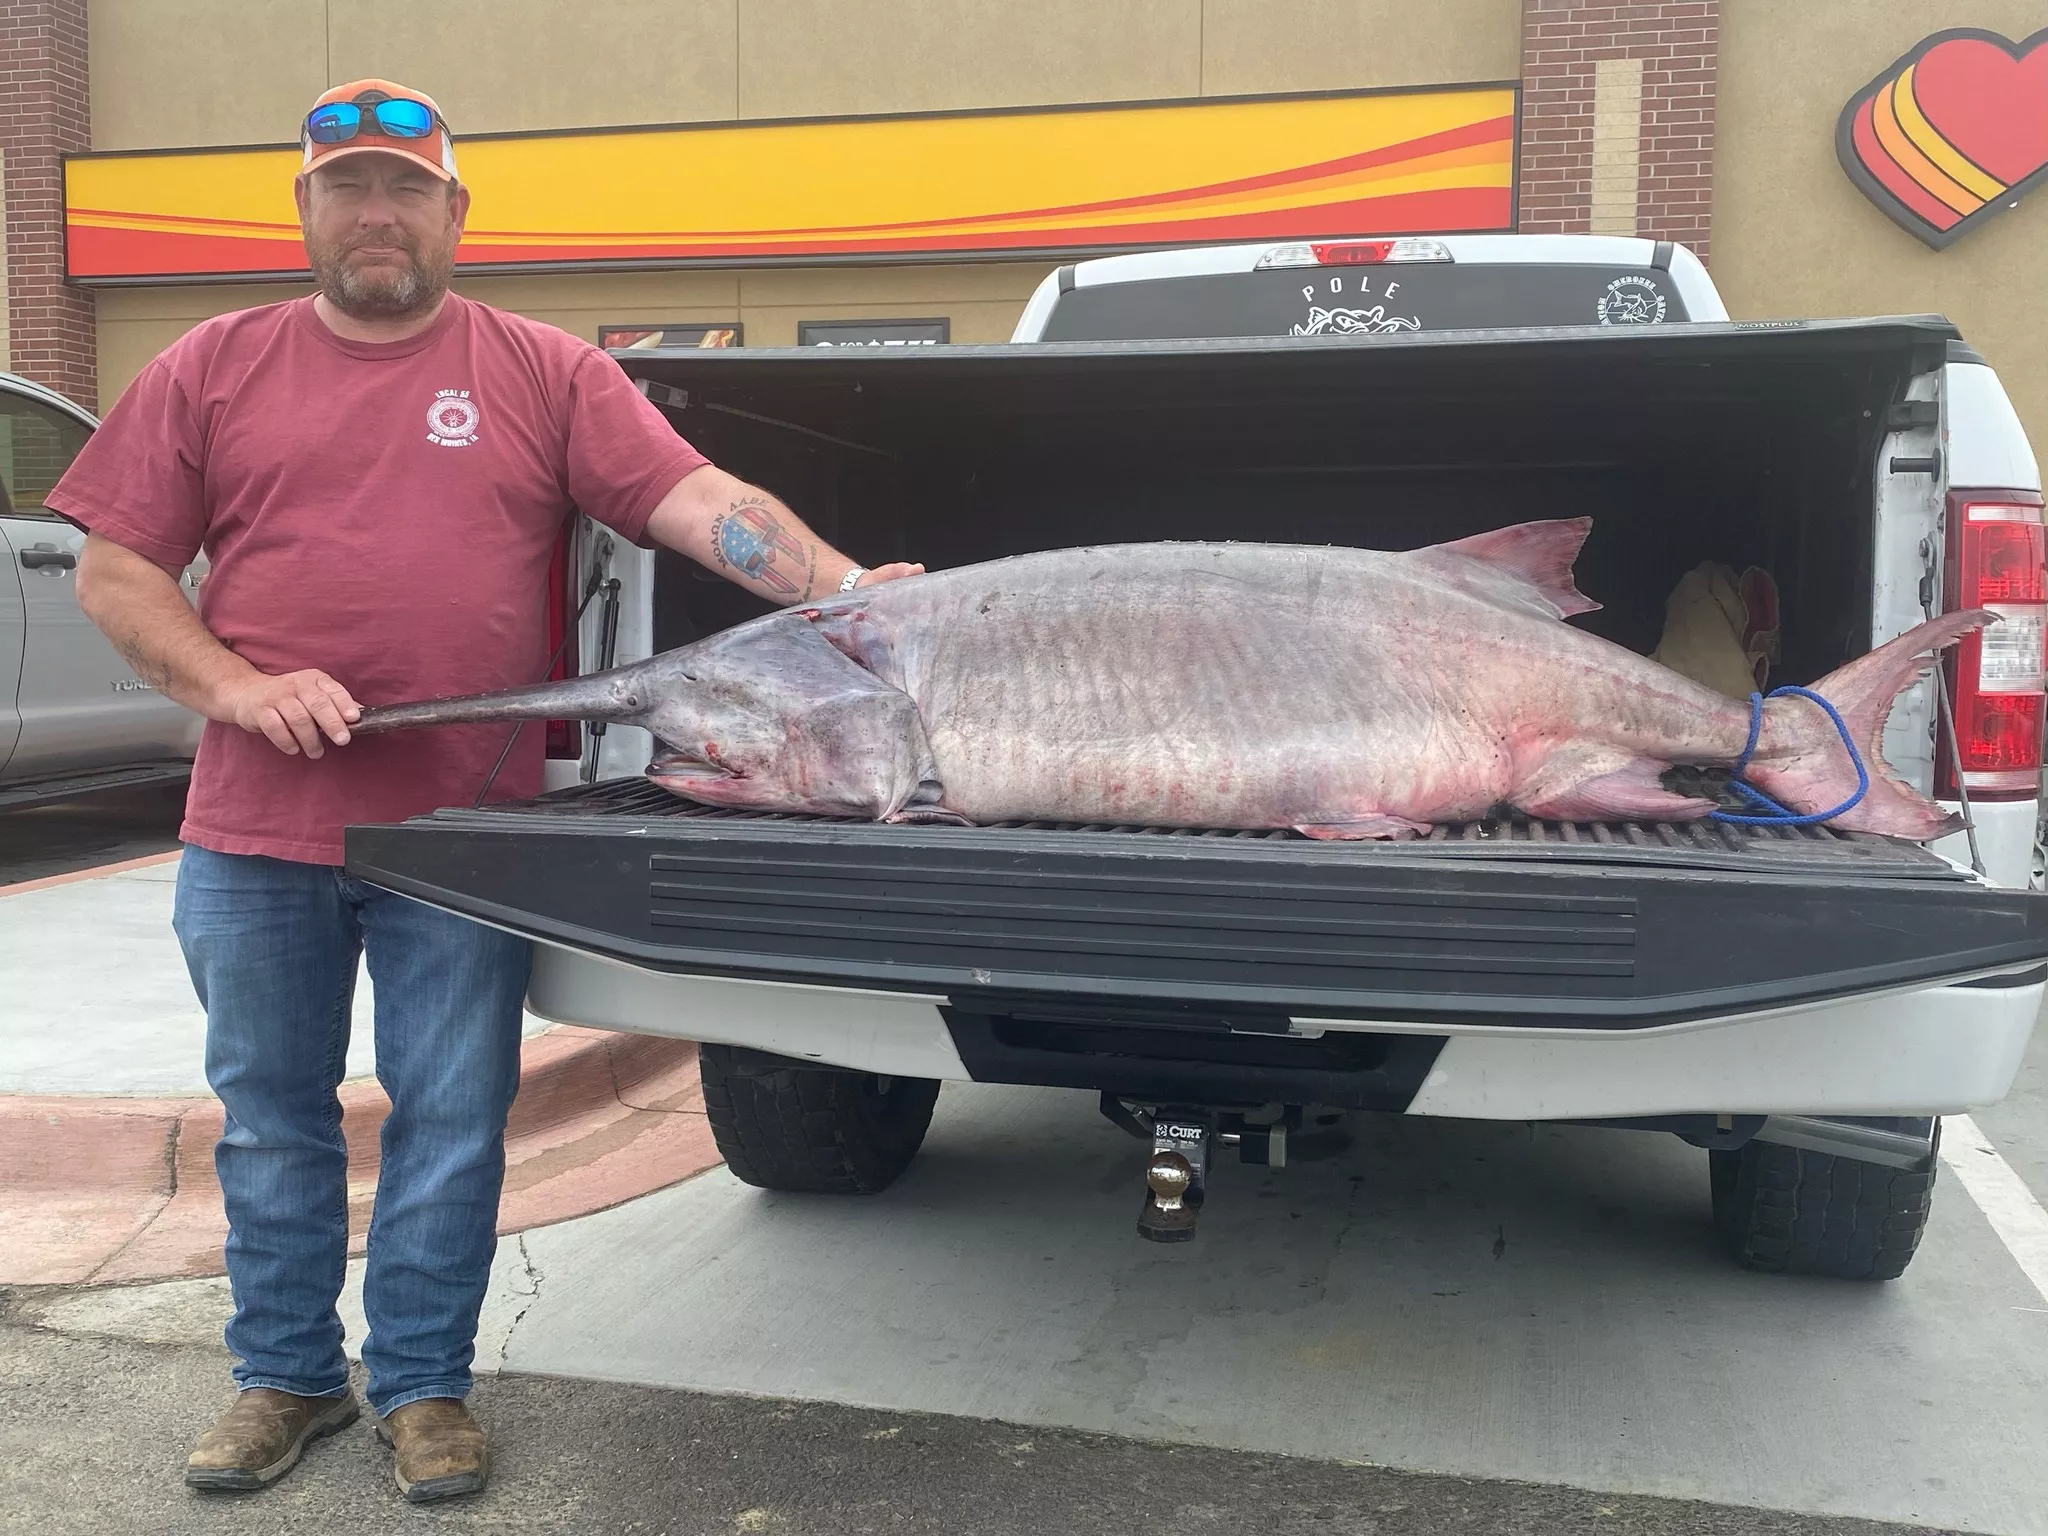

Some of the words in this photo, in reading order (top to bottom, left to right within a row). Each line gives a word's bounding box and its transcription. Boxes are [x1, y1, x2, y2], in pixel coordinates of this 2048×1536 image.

[1302, 276, 1400, 302] POLE
[1738, 321, 1800, 329] MOSTPLUS
[434, 389, 458, 399] LOCAL
[1169, 1125, 1202, 1139] CURT
